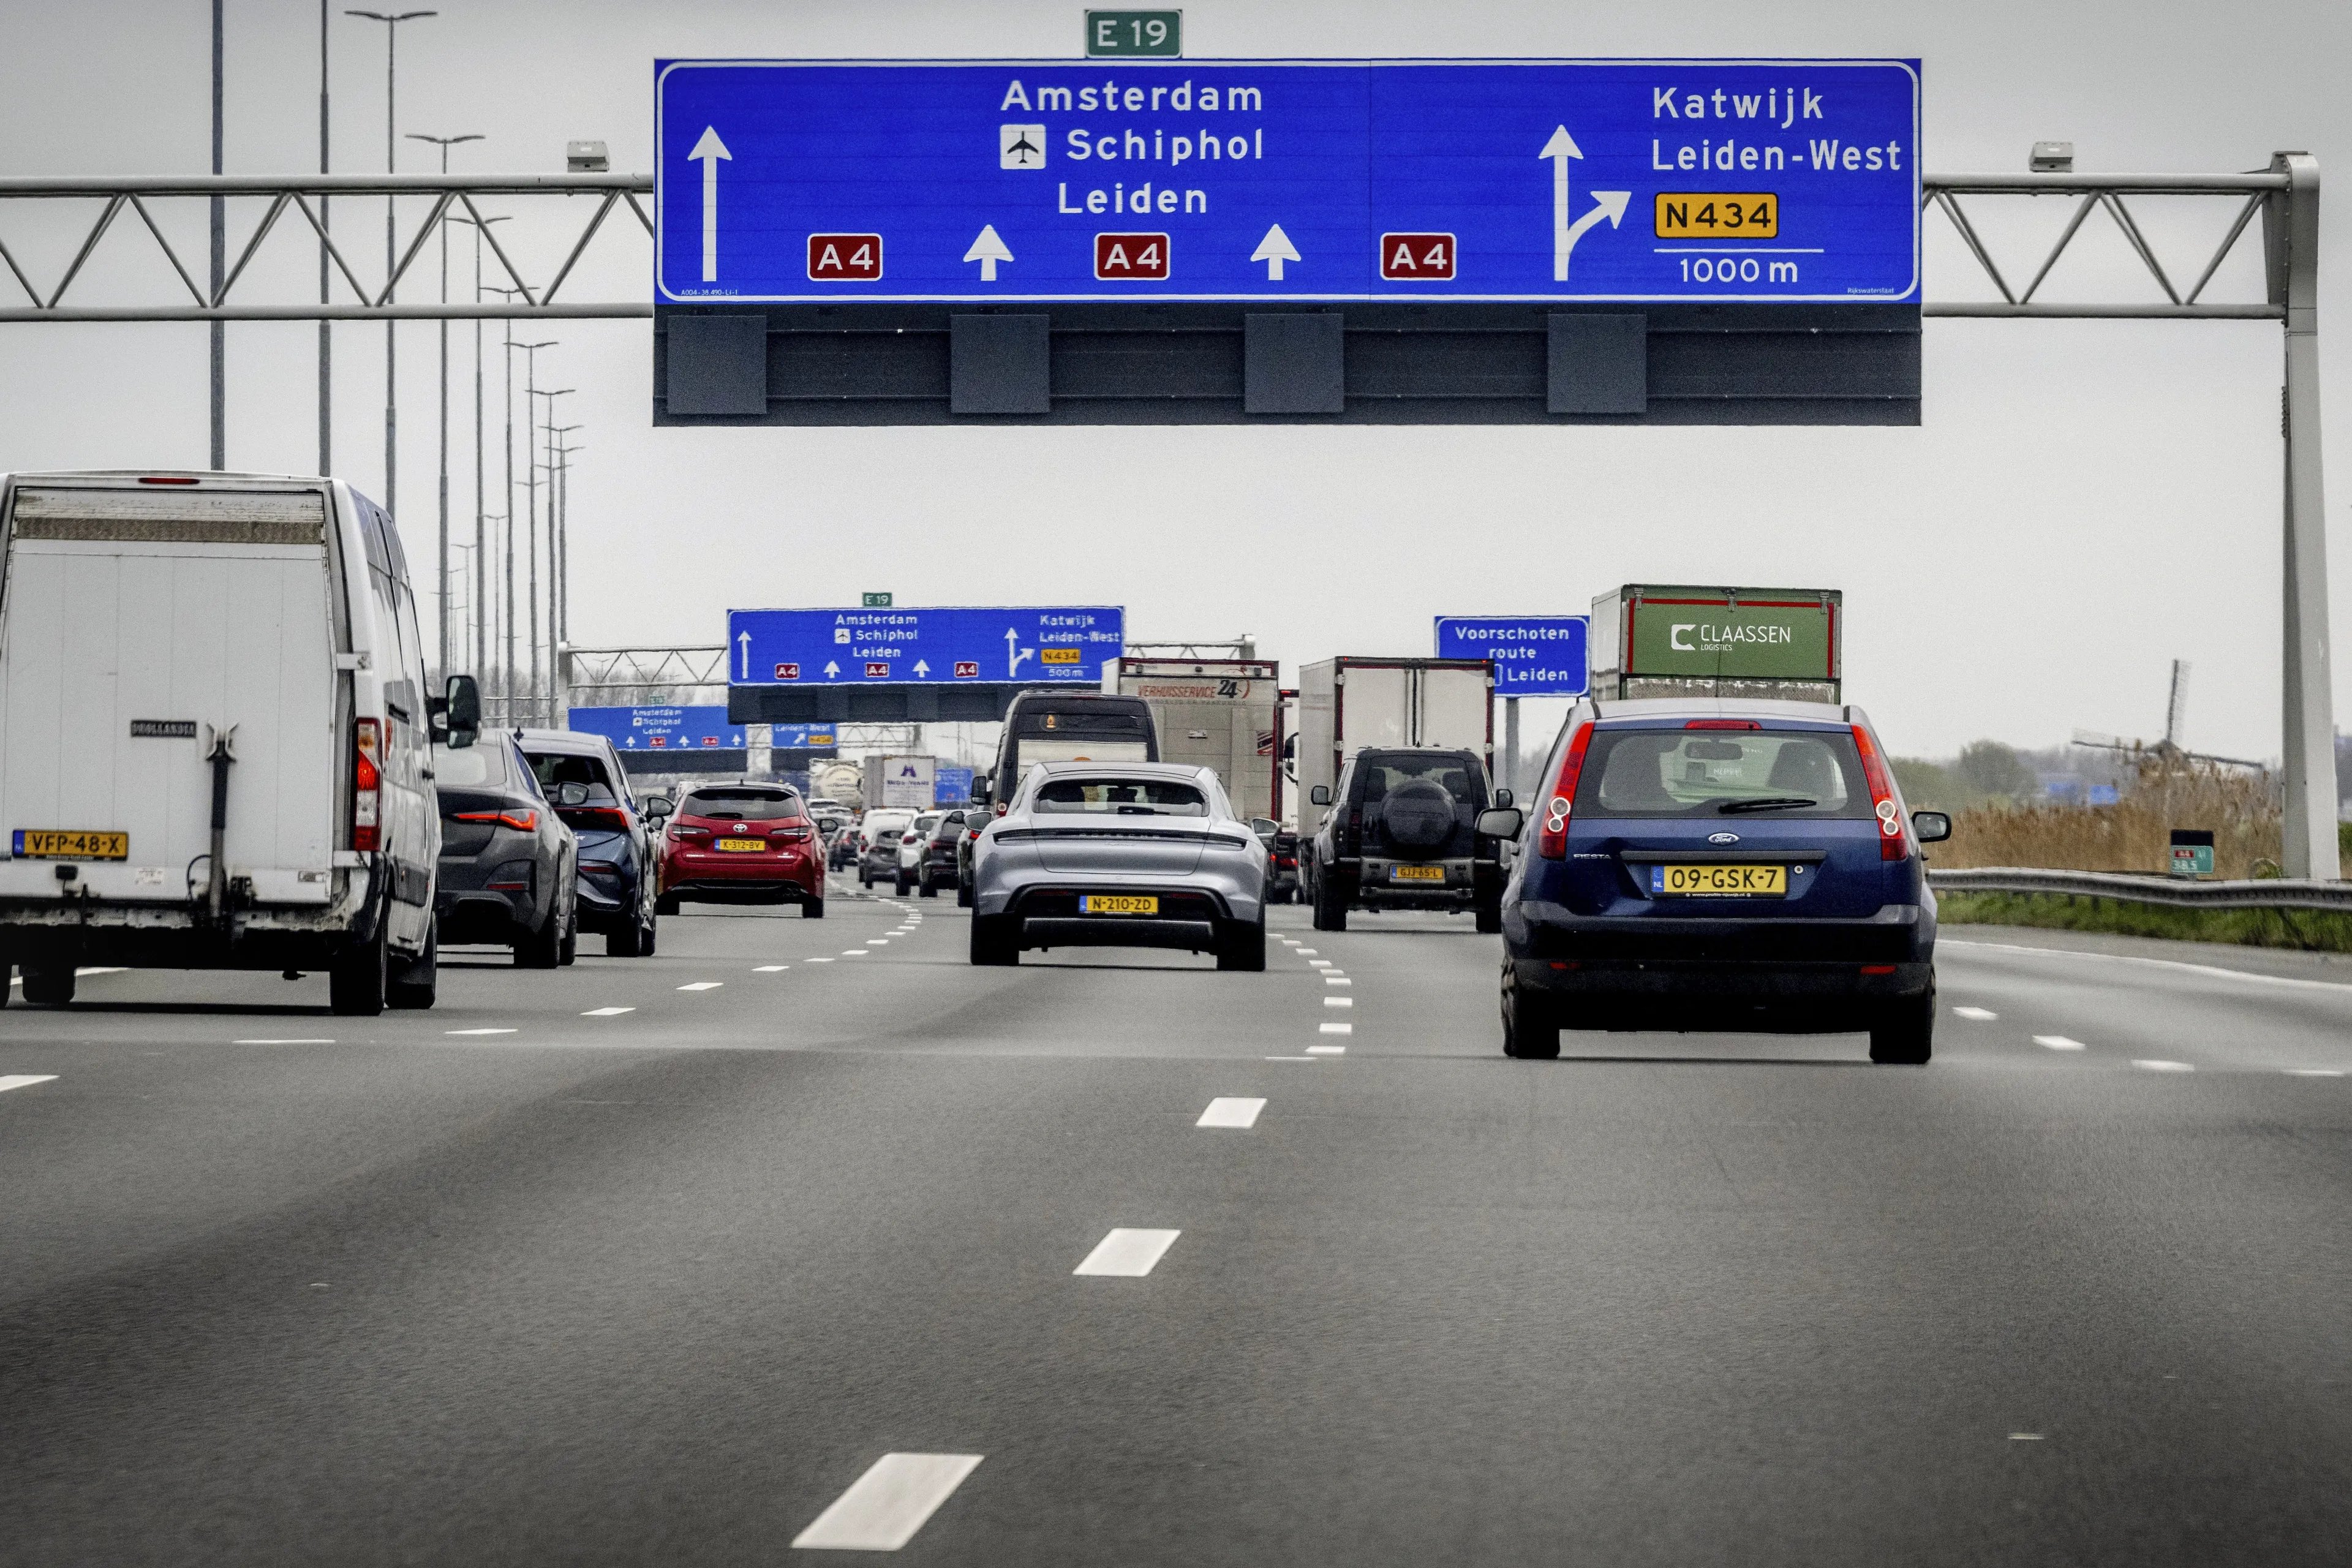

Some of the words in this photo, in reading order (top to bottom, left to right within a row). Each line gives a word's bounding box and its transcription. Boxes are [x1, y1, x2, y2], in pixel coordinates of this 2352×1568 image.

[1097, 20, 1118, 47] E
[1131, 20, 1167, 47] 19
[1001, 80, 1262, 111] Amsterdam
[1654, 87, 1823, 129] Katwijk
[1066, 129, 1262, 166] Schiphol
[1653, 139, 1901, 170] Leiden-West
[1059, 182, 1207, 214] Leiden
[1667, 202, 1771, 228] N434
[817, 244, 873, 270] A4
[1104, 243, 1161, 270] A4
[1390, 243, 1447, 270] A4
[1680, 258, 1760, 282] 1000
[1769, 262, 1798, 283] m
[865, 595, 873, 605] E
[876, 595, 888, 605] 19
[835, 614, 918, 625] Amsterdam
[1040, 615, 1095, 628] Katwijk
[856, 629, 918, 642] Schiphol
[1039, 631, 1120, 643] Leiden-West
[1455, 627, 1569, 640] Voorschoten
[1700, 624, 1790, 643] CLAASSEN
[853, 647, 901, 658] Leiden
[1044, 652, 1078, 660] N434
[1489, 646, 1536, 659] route
[777, 666, 797, 676] A4
[869, 666, 887, 674] A4
[957, 665, 976, 674] A4
[1507, 668, 1568, 682] Leiden
[1138, 685, 1216, 698] VERHUISSERVICE
[1217, 679, 1238, 699] 24
[32, 834, 120, 853] VFP-48-X
[1672, 869, 1777, 889] 09-GSK-7
[1093, 897, 1152, 910] N-210-ZD
